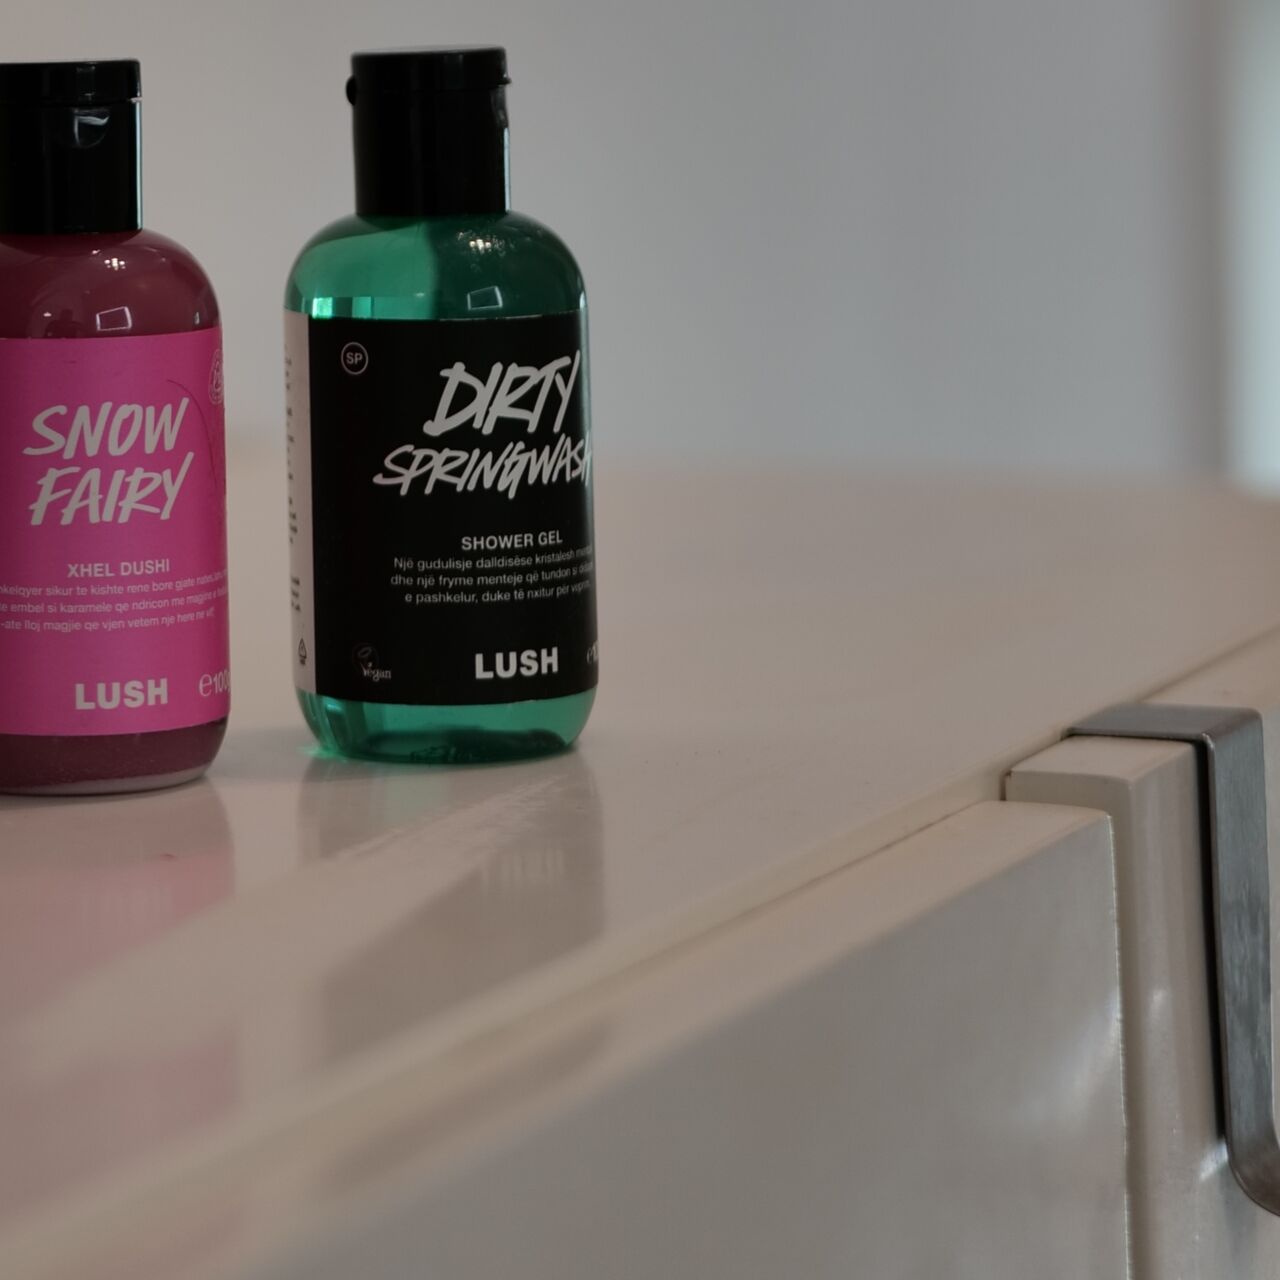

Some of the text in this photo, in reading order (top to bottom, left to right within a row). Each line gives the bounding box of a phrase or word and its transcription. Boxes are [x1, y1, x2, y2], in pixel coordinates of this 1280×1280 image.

[345, 351, 363, 365] SP
[422, 349, 580, 437] DIRTY
[23, 397, 189, 460] SNOW
[372, 431, 591, 500] SPRINGWASH
[28, 451, 194, 526] FAIRY
[461, 530, 563, 550] SHOWER GEL
[67, 558, 170, 578] XHEL DUSHI
[390, 574, 413, 585] dhe
[404, 592, 412, 602] e
[481, 589, 511, 601] duke
[475, 646, 559, 680] LUSH
[75, 678, 168, 711] LUSH
